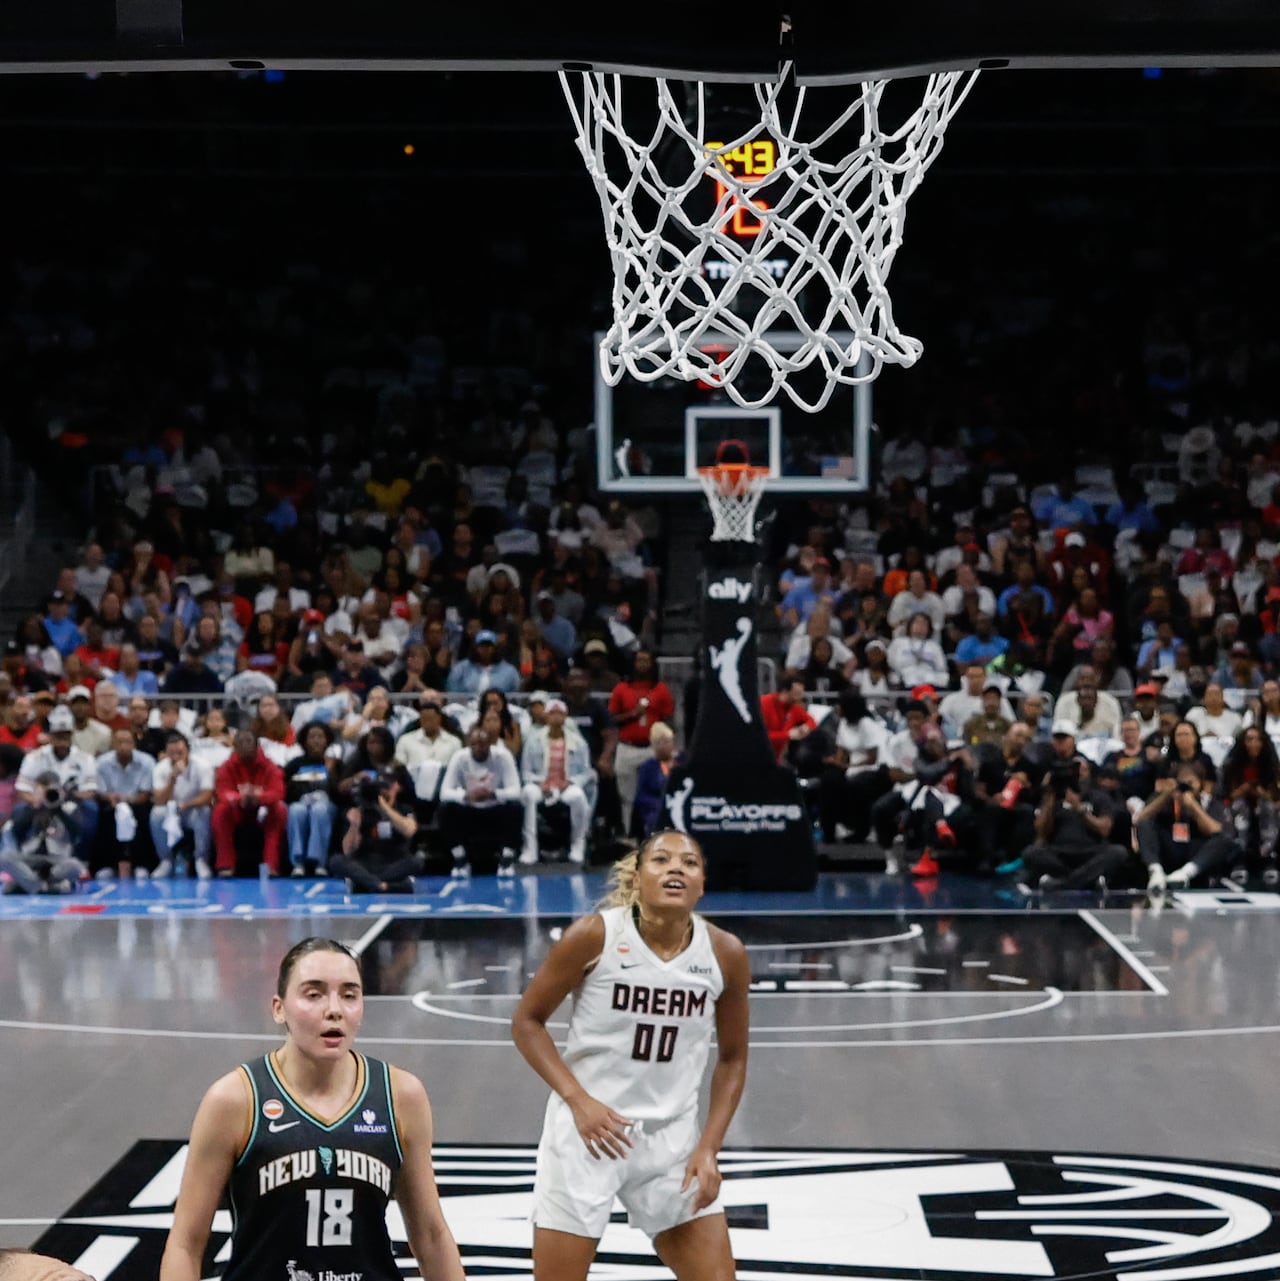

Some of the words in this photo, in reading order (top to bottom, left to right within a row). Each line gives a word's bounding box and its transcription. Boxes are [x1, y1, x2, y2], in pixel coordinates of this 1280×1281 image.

[708, 577, 752, 604] ally
[690, 804, 802, 820] PLAYOFFS
[688, 964, 713, 975] Albert
[611, 982, 708, 1018] DREAM
[631, 1022, 679, 1063] 00
[354, 1123, 388, 1133] BARCLAYS
[258, 1148, 317, 1196] NEW
[334, 1148, 392, 1198] YORK
[305, 1188, 354, 1247] 18
